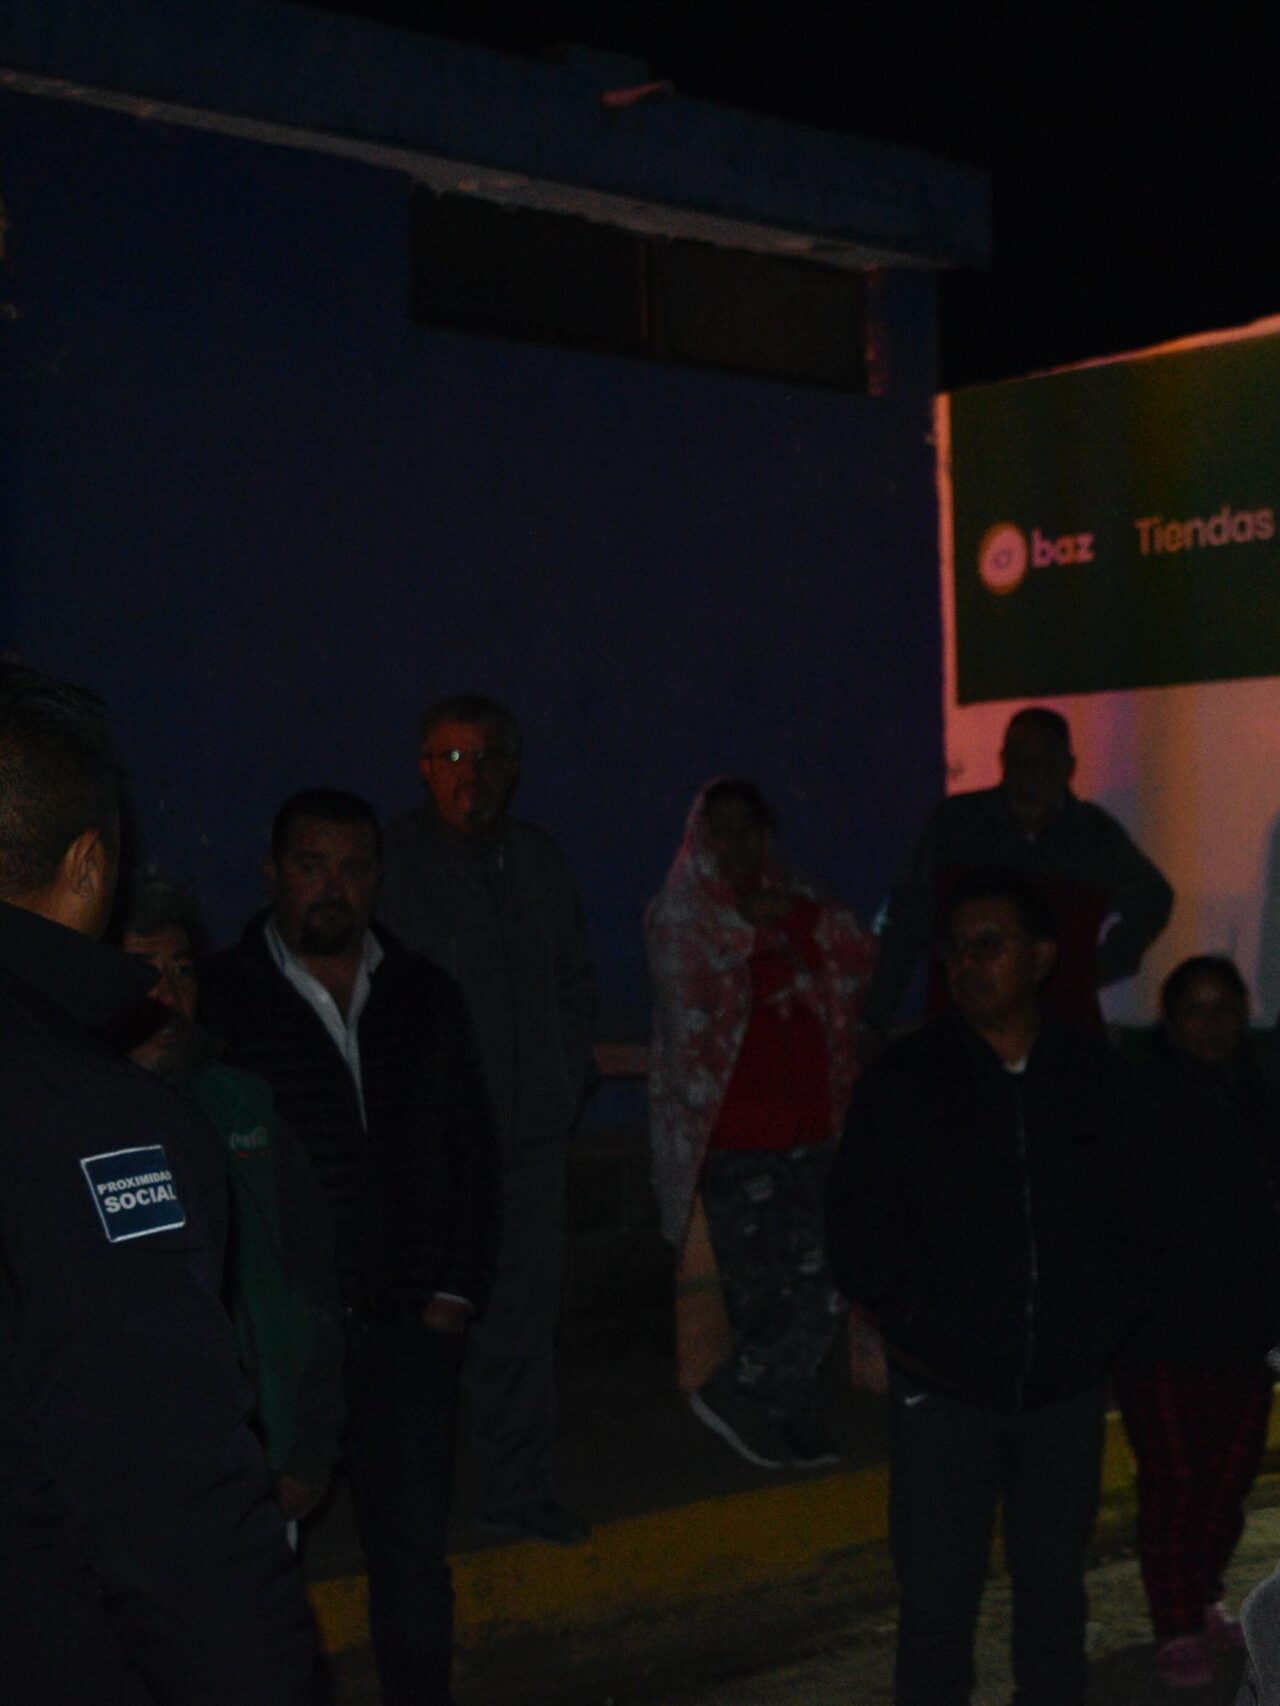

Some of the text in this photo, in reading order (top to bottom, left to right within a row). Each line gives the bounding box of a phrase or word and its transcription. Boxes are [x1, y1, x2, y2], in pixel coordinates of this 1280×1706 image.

[1030, 528, 1095, 568] baz
[1135, 505, 1276, 556] Tiendas
[96, 1170, 173, 1195] PROXIMIDAD
[103, 1183, 178, 1214] SOCIAL
